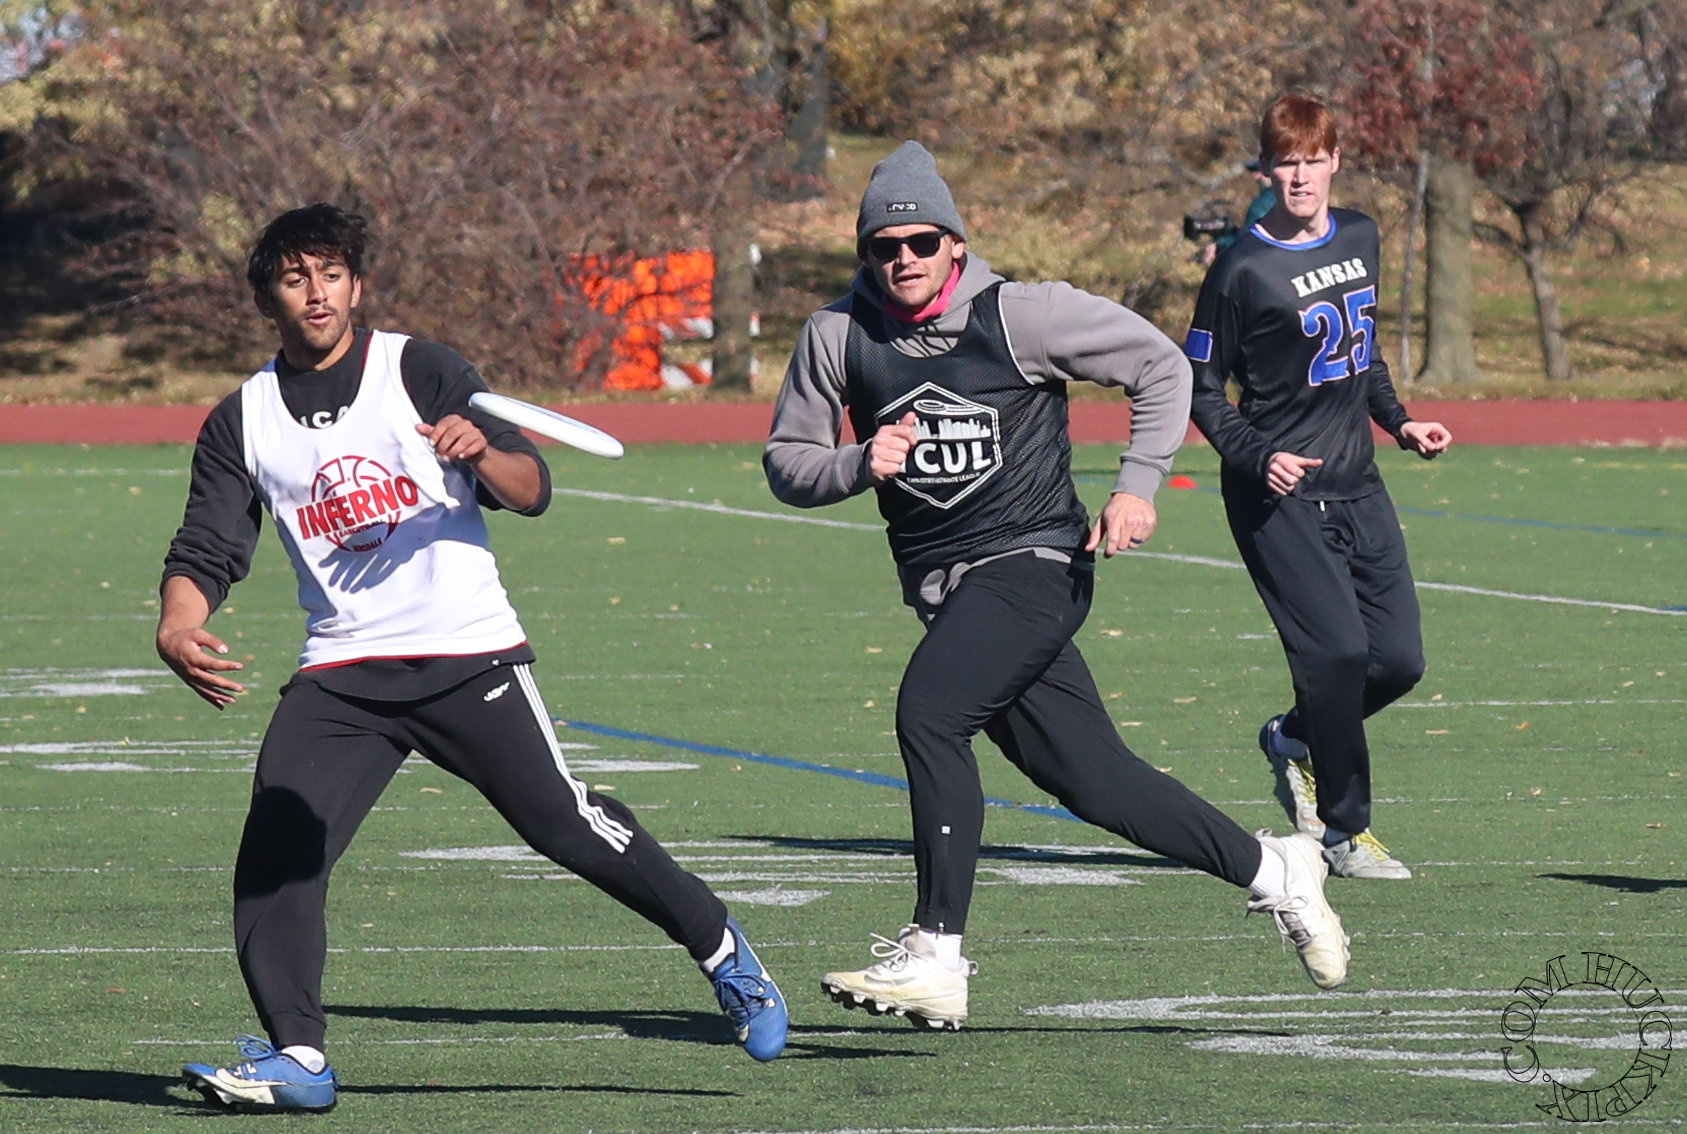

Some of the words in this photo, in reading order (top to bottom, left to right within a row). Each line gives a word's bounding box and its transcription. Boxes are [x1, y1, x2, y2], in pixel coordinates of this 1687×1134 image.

[1291, 257, 1368, 298] KANSAS
[1298, 284, 1377, 387] 25
[899, 441, 992, 474] CUL
[296, 475, 419, 540] INFERNO
